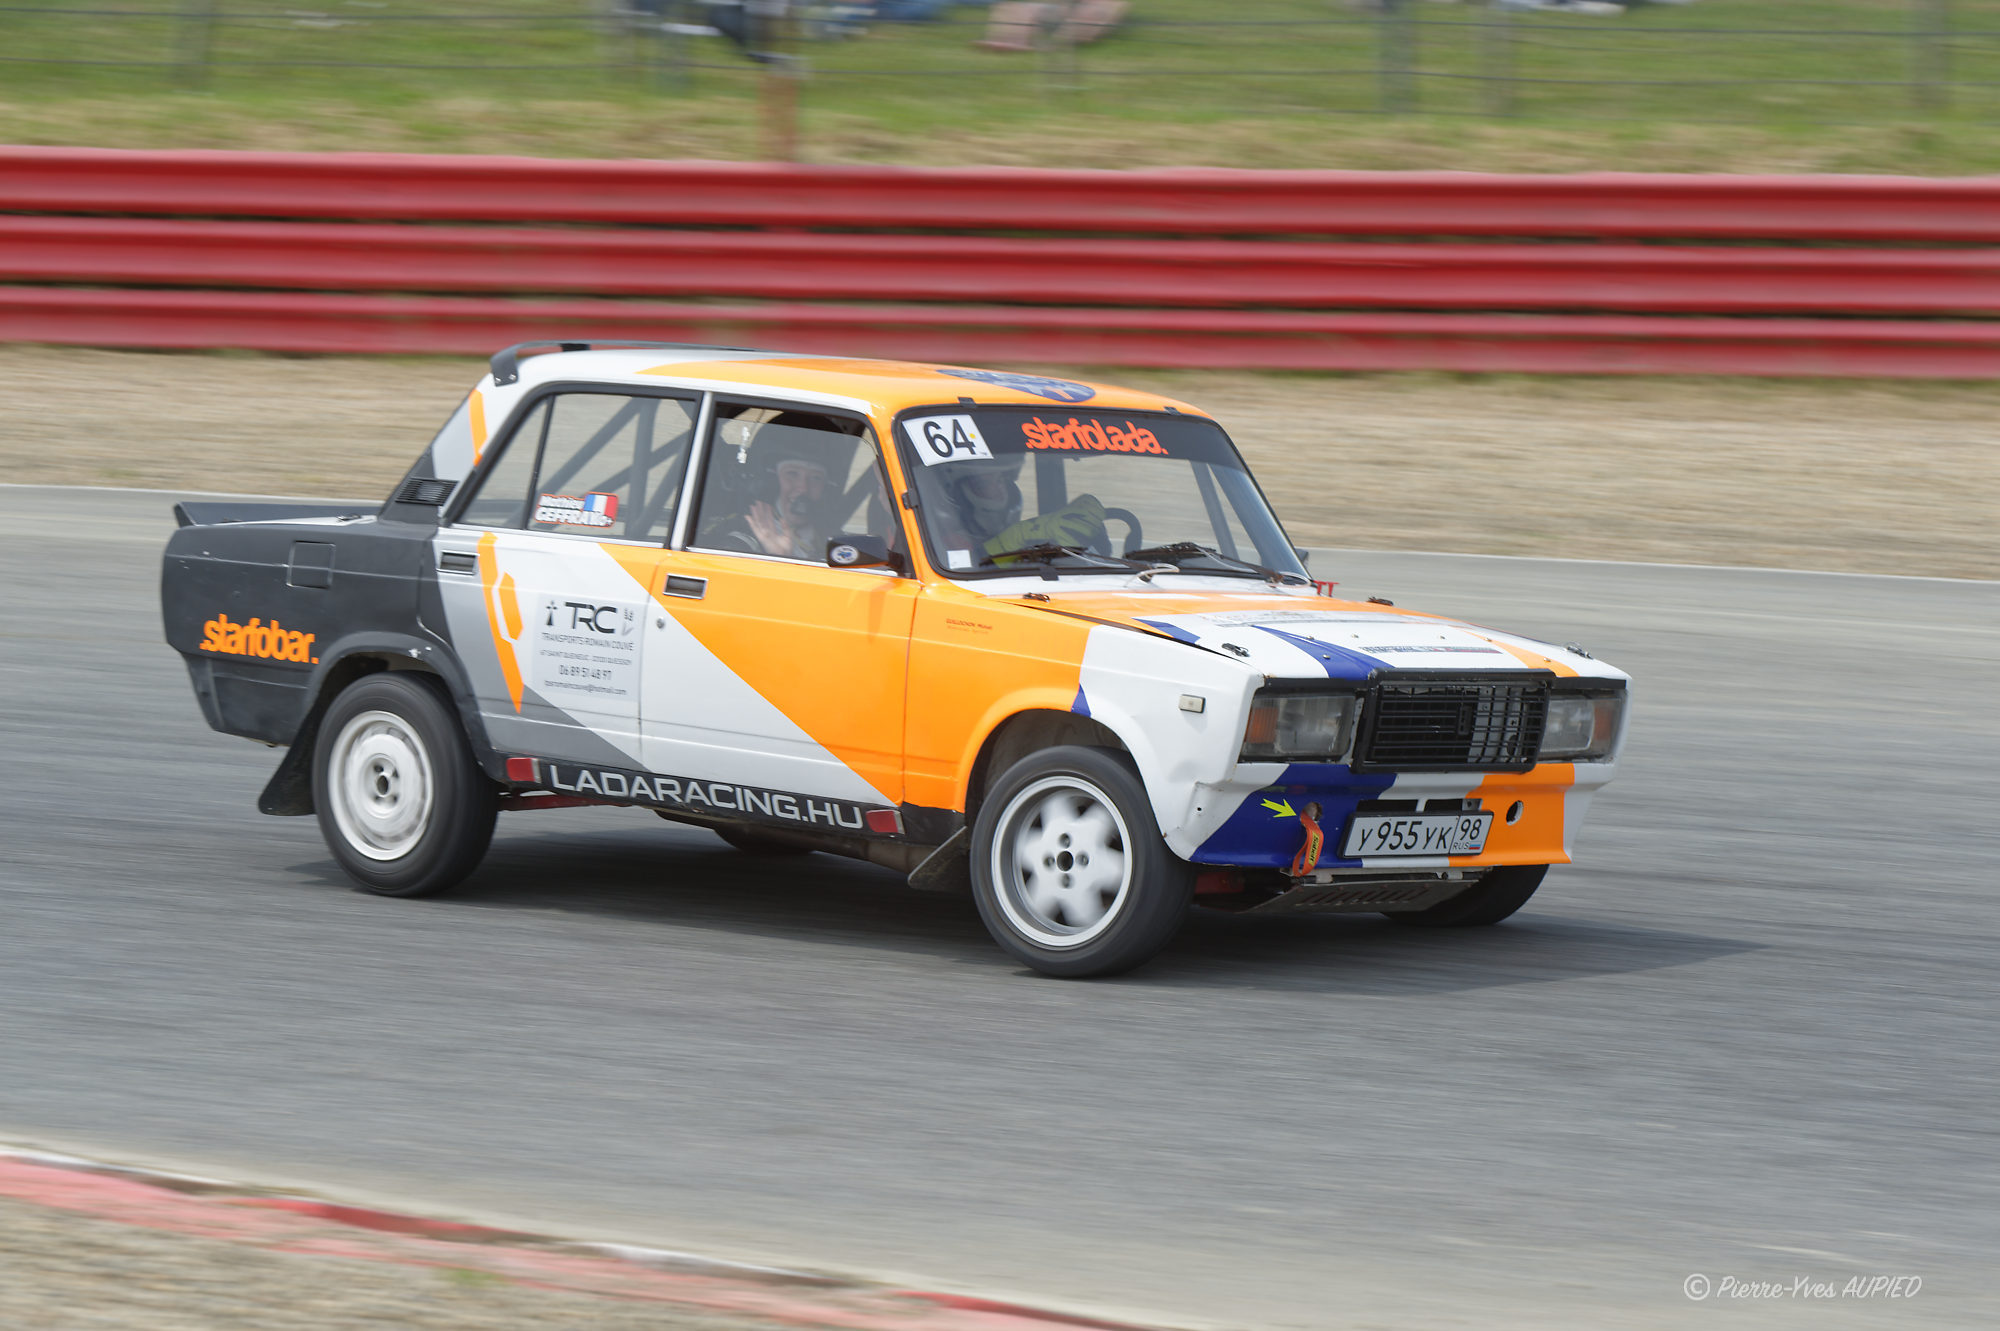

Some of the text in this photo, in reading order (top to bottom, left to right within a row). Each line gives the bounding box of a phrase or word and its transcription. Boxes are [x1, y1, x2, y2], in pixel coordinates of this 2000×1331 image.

[922, 418, 976, 458] 64
[565, 601, 618, 634] TRC
[549, 764, 864, 829] LADARACING.HU
[1453, 842, 1470, 850] RUS
[1459, 818, 1482, 841] 98
